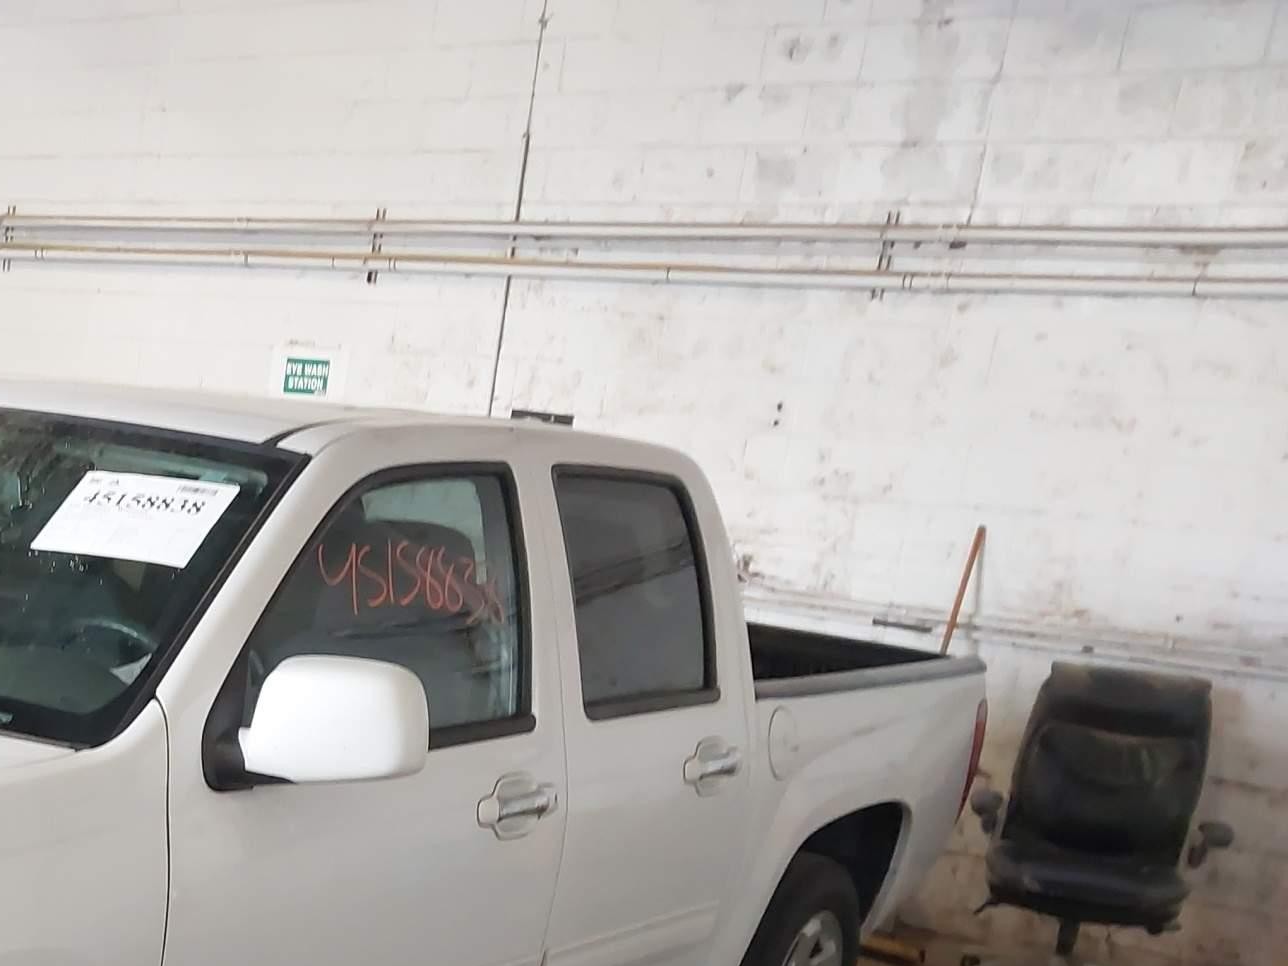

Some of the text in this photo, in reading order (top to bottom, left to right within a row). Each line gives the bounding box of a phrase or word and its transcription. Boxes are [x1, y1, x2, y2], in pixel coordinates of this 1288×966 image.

[304, 362, 329, 377] WASH
[286, 376, 324, 391] STATION
[83, 490, 207, 516] 45158838
